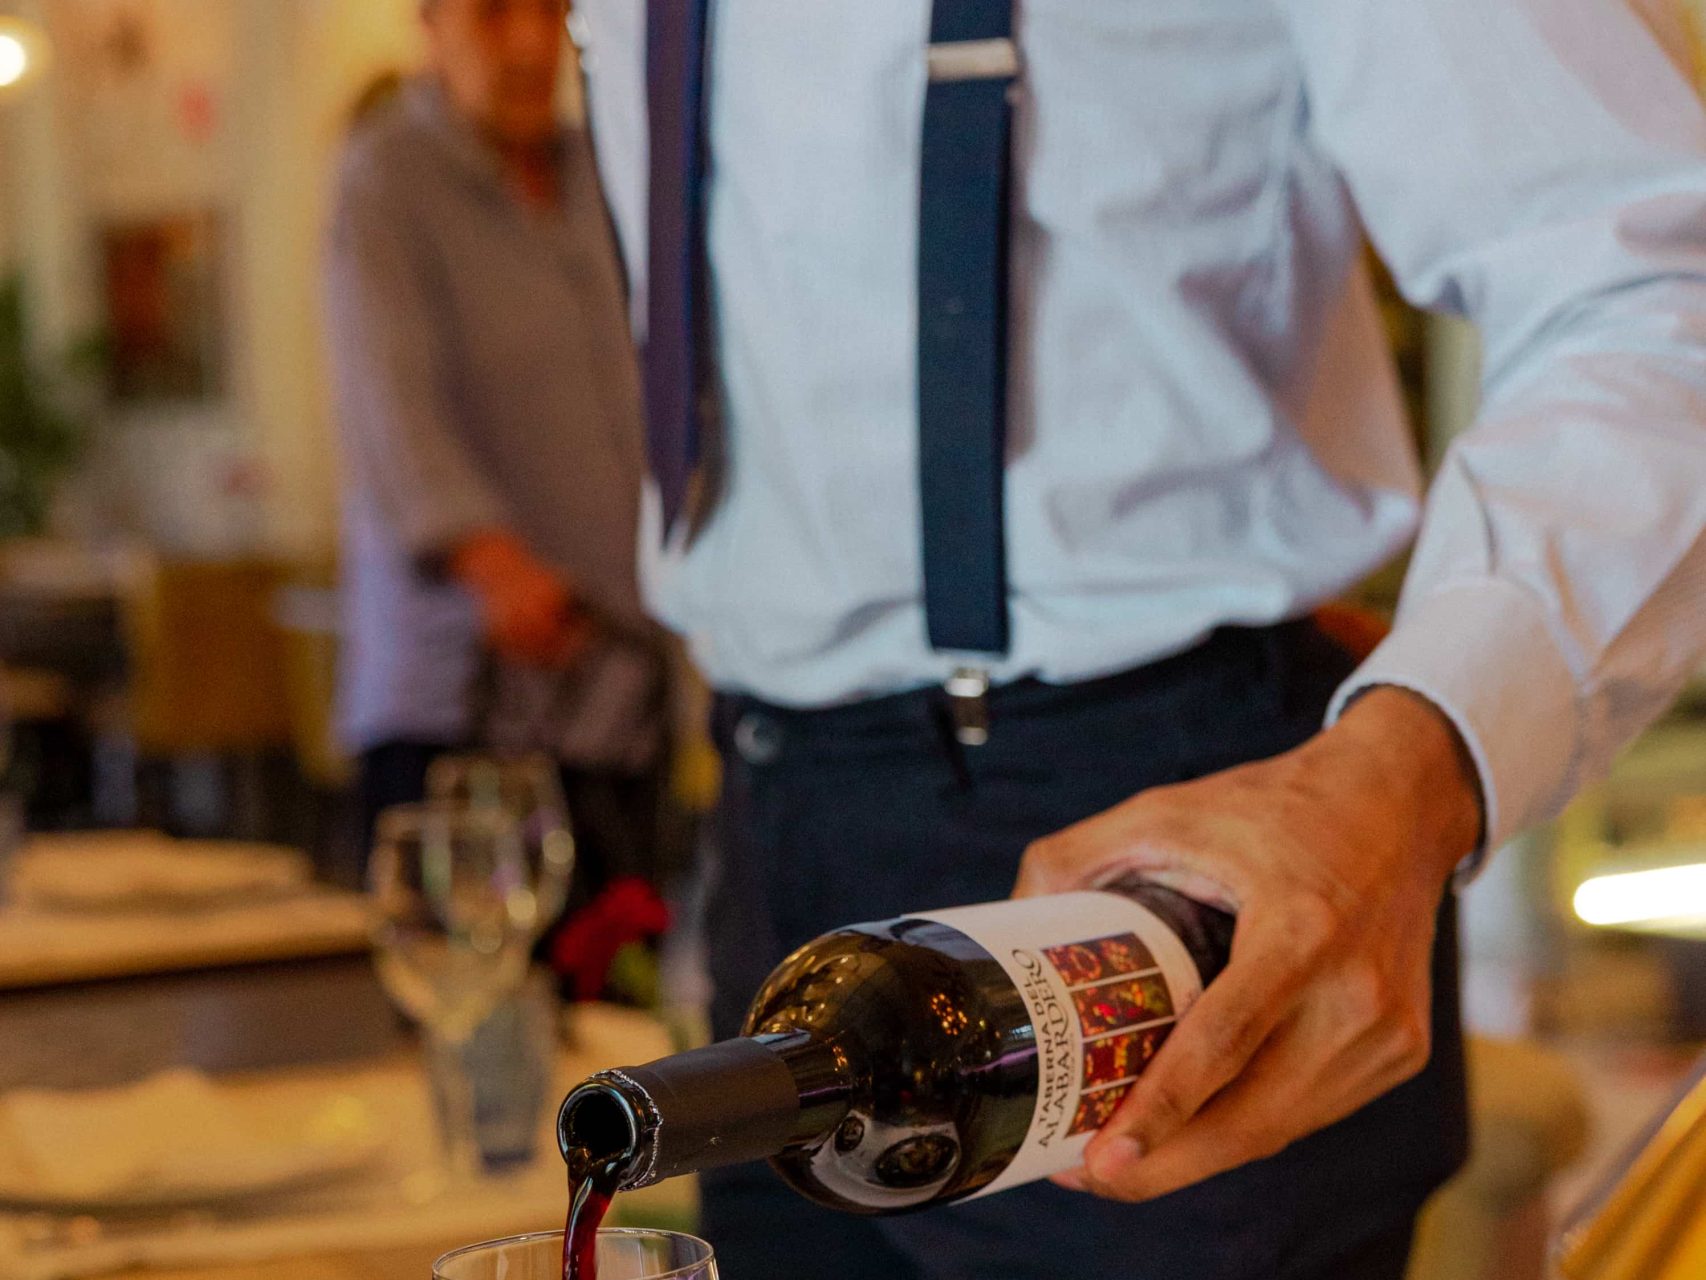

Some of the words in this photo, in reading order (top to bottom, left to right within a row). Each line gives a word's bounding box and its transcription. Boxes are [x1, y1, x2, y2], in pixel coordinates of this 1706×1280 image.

[1012, 948, 1070, 1147] ALABARDERO
[1023, 980, 1045, 1015] DEL
[1038, 1023, 1053, 1126] TABERNA
